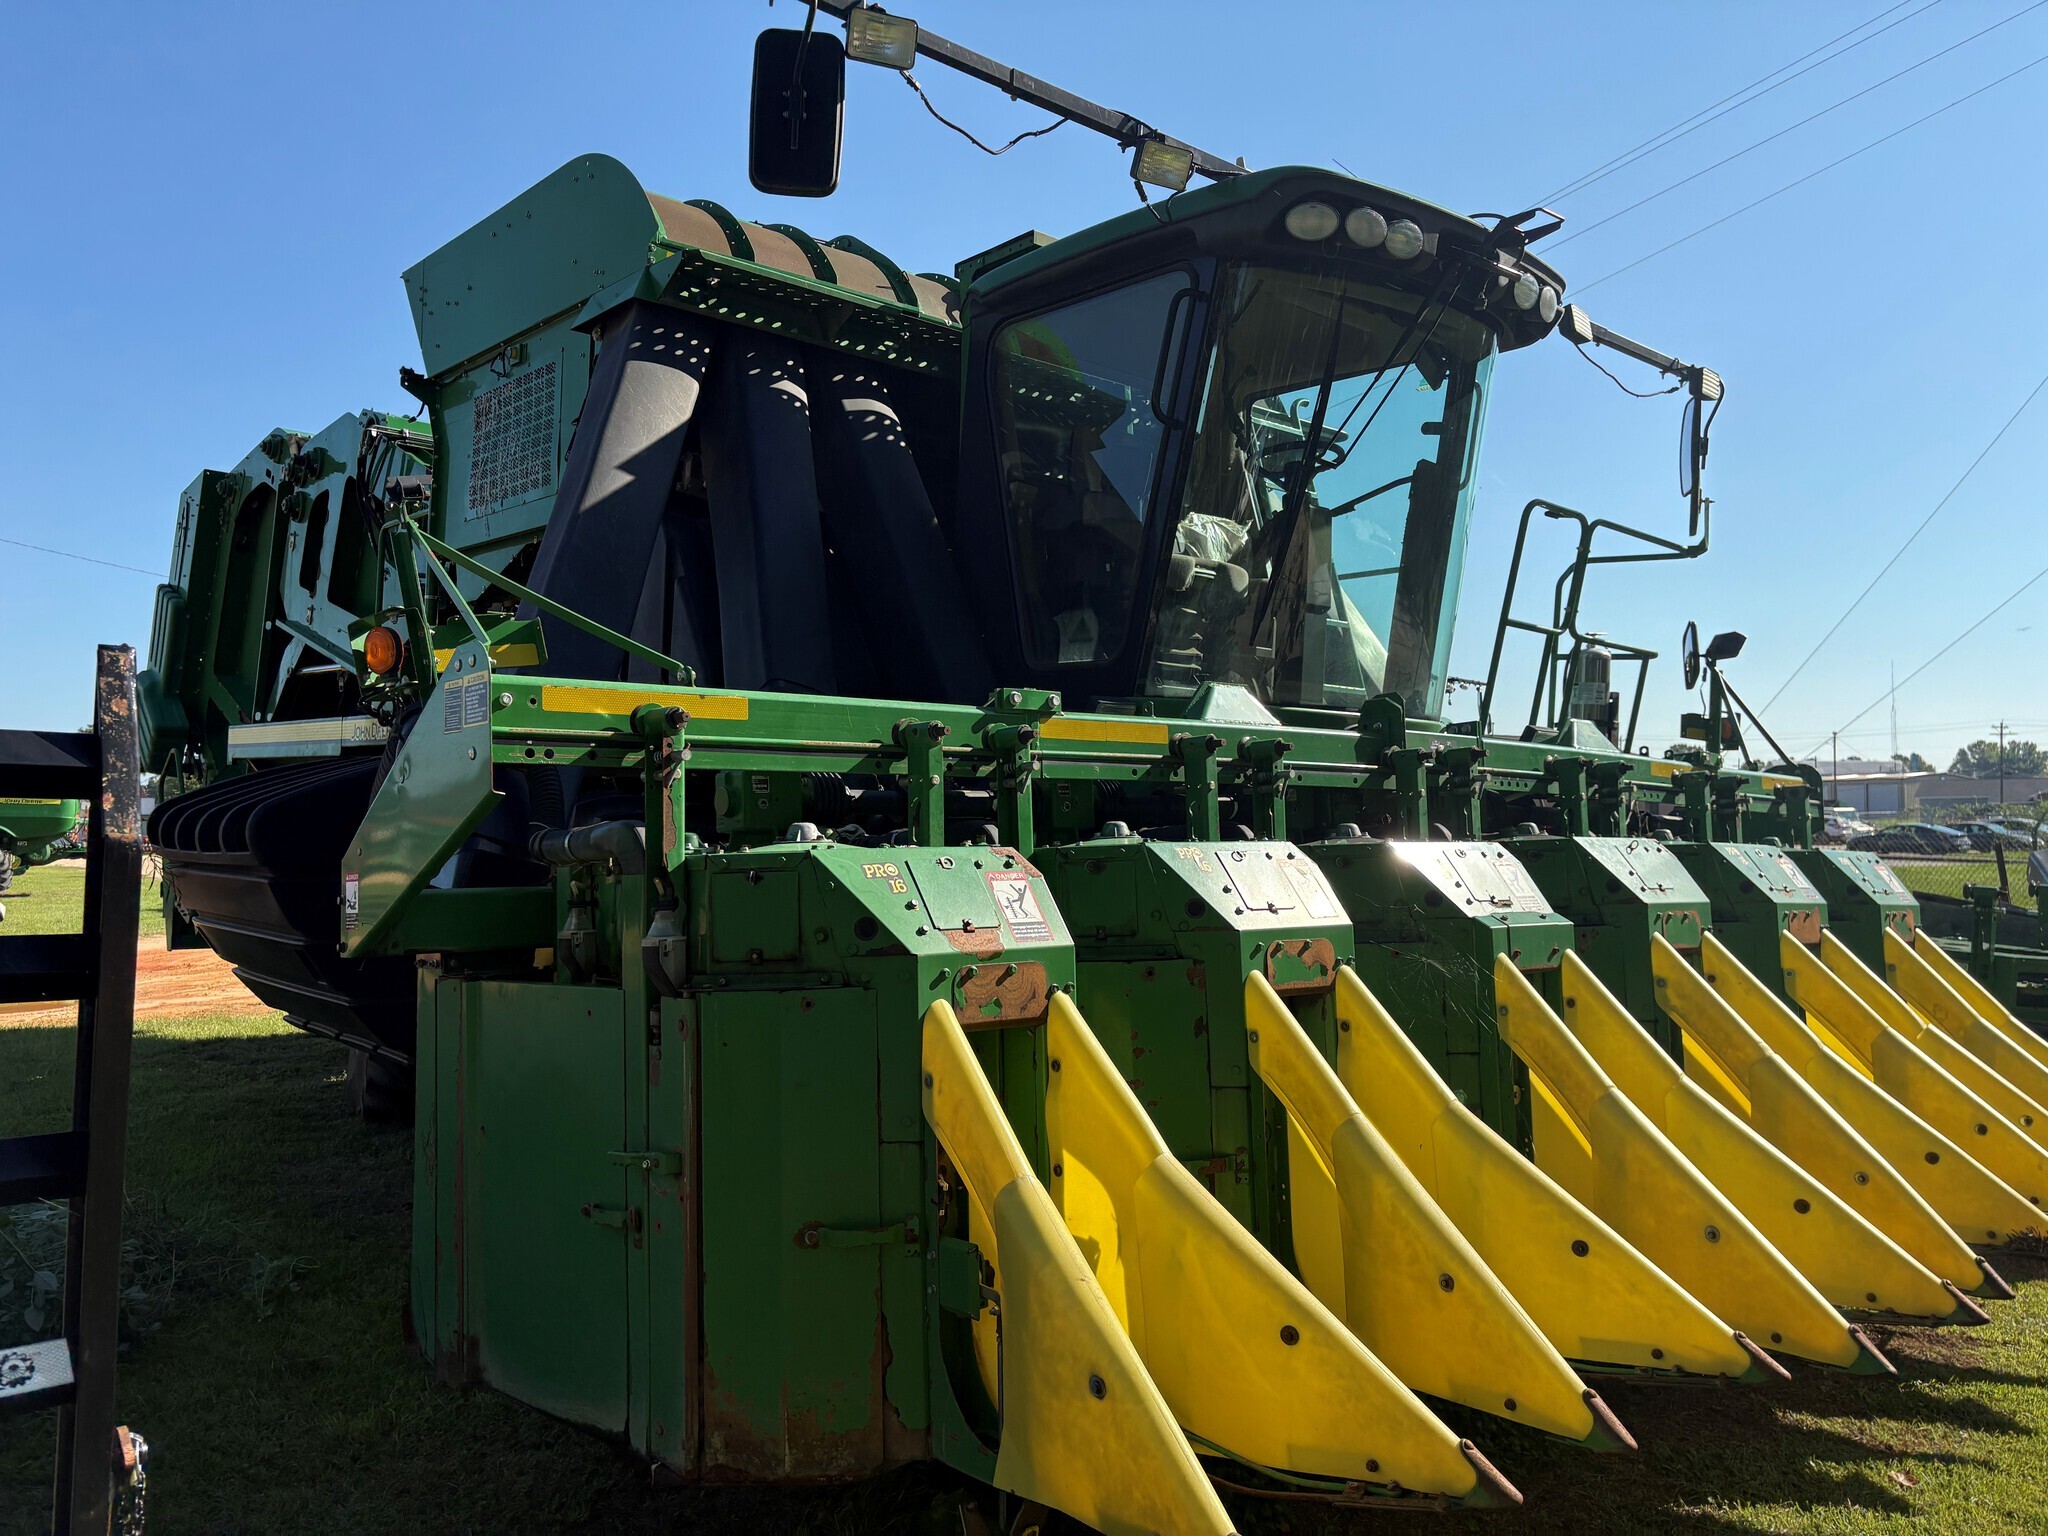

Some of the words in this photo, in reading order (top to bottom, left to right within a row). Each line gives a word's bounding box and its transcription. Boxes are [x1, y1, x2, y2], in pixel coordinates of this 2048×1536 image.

[352, 723, 371, 739] JOHN
[862, 863, 899, 878] PRO
[995, 872, 1026, 880] DANGER
[889, 879, 908, 893] 16
